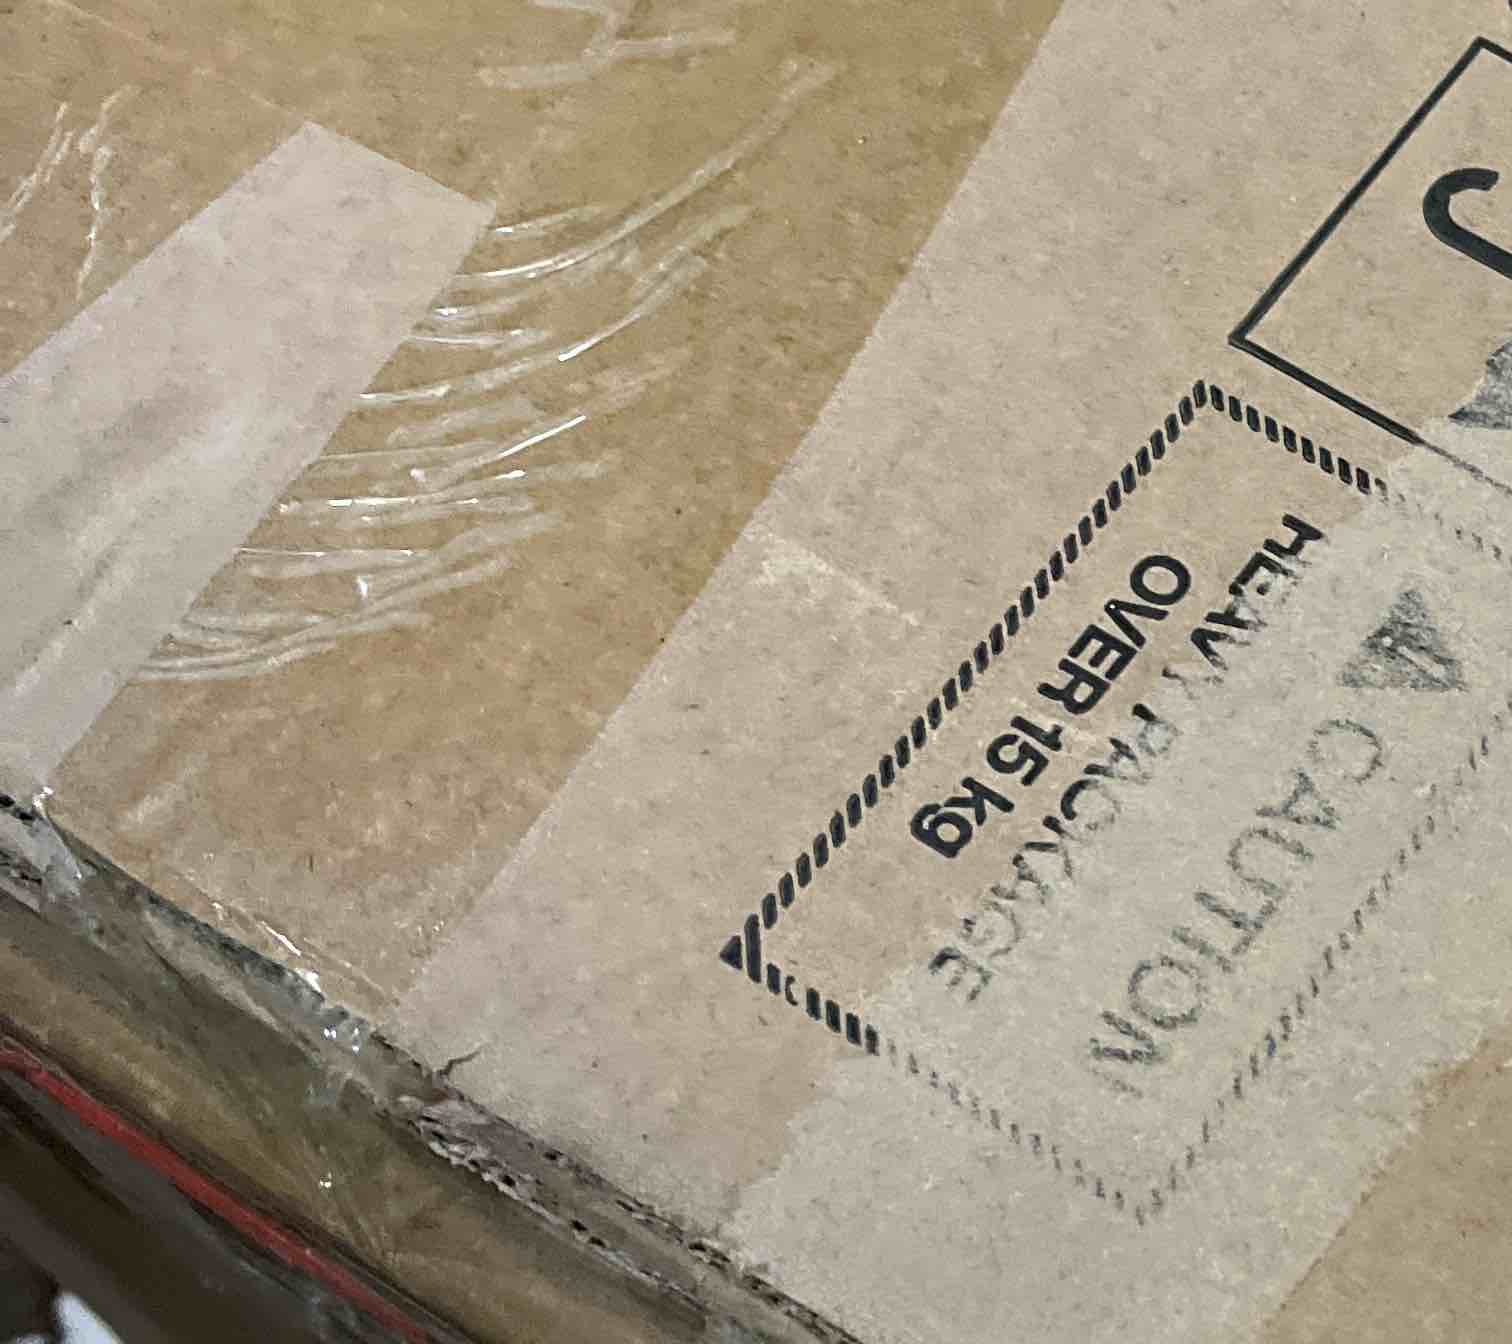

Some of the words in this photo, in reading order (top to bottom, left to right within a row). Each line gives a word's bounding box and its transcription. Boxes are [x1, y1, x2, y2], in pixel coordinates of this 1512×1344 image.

[1039, 555, 1191, 714] OVER
[986, 716, 1061, 785] 15
[910, 777, 1014, 857] kg
[1090, 718, 1383, 1098] CAUTION
